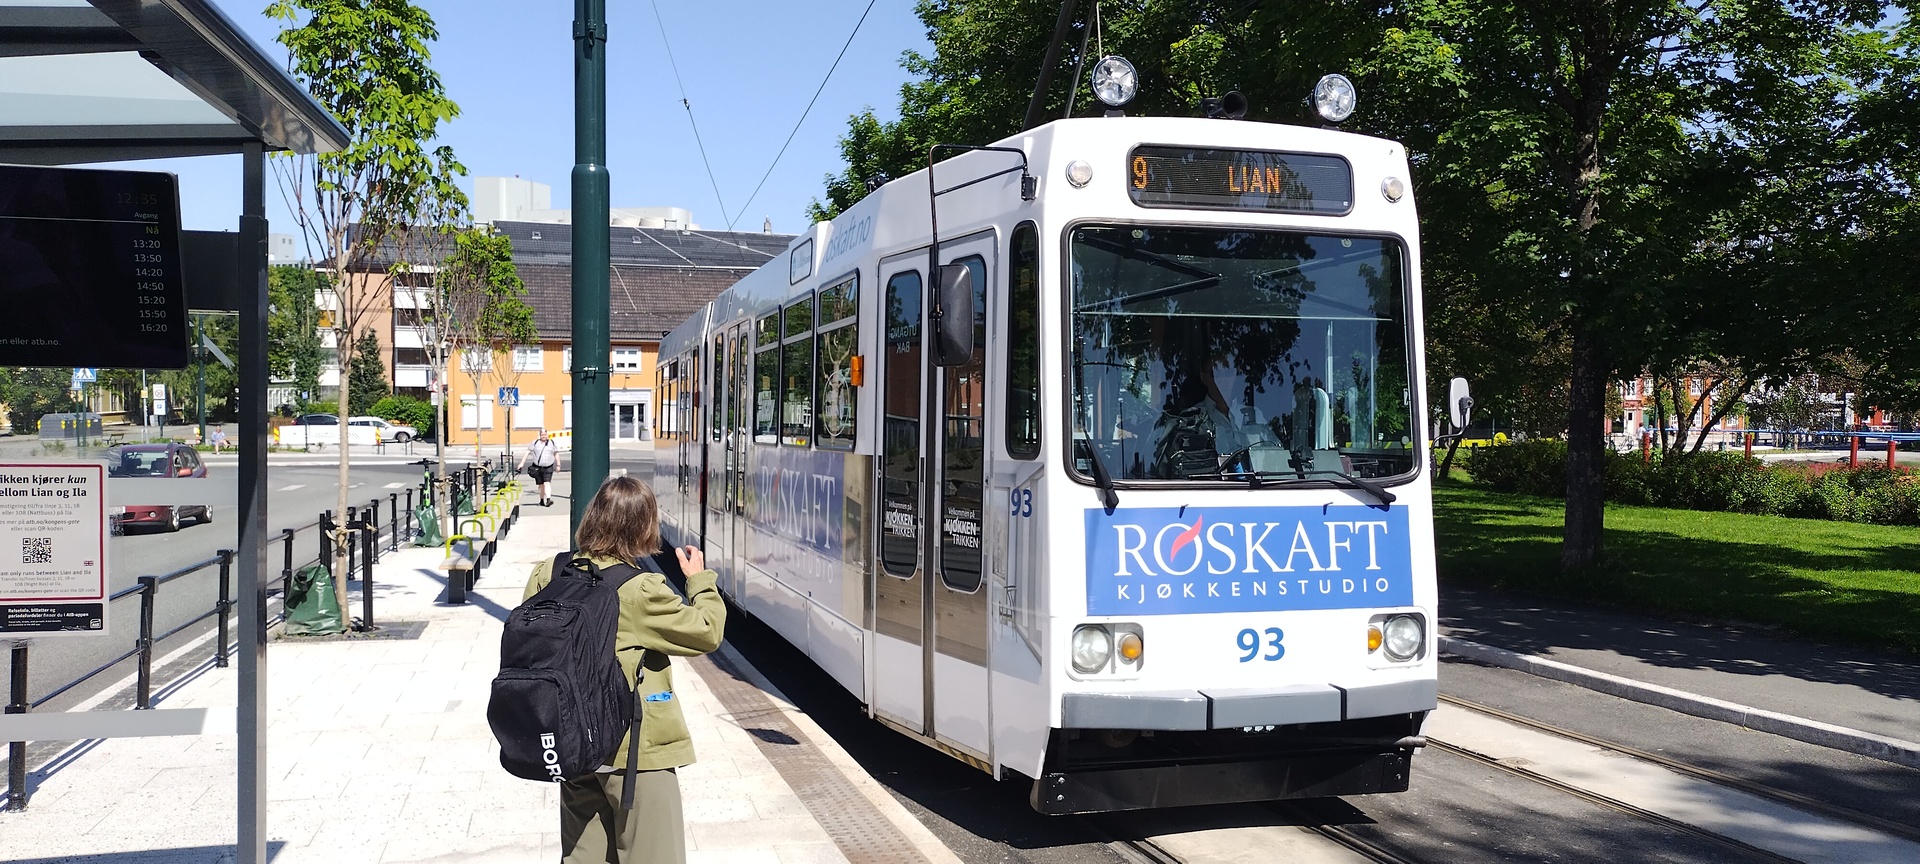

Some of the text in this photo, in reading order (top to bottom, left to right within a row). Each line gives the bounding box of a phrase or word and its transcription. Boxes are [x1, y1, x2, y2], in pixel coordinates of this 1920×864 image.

[1134, 156, 1280, 193] 9 LIAN
[134, 212, 158, 220] Avgang
[146, 226, 159, 235] Nå
[133, 240, 160, 249] 13:20
[135, 254, 161, 263] 13:50
[136, 268, 163, 277] 14:20
[137, 282, 164, 291] 14:50
[138, 296, 165, 305] 15:20
[140, 310, 166, 319] 15:50
[141, 323, 167, 332] 16:20
[10, 337, 28, 345] eller
[33, 475, 64, 485] kjører
[68, 475, 87, 484] kun
[32, 488, 53, 497] Lian
[57, 490, 69, 499] og
[73, 488, 87, 497] Ila
[1011, 488, 1032, 518] 93
[886, 509, 913, 526] KJØKKEN
[946, 516, 976, 535] KJØKKEN
[892, 524, 915, 538] TRIKKEN
[952, 533, 979, 549] TRIKKEN
[1118, 577, 1389, 604] KJØKKENSTUDIO
[1236, 627, 1285, 663] 93
